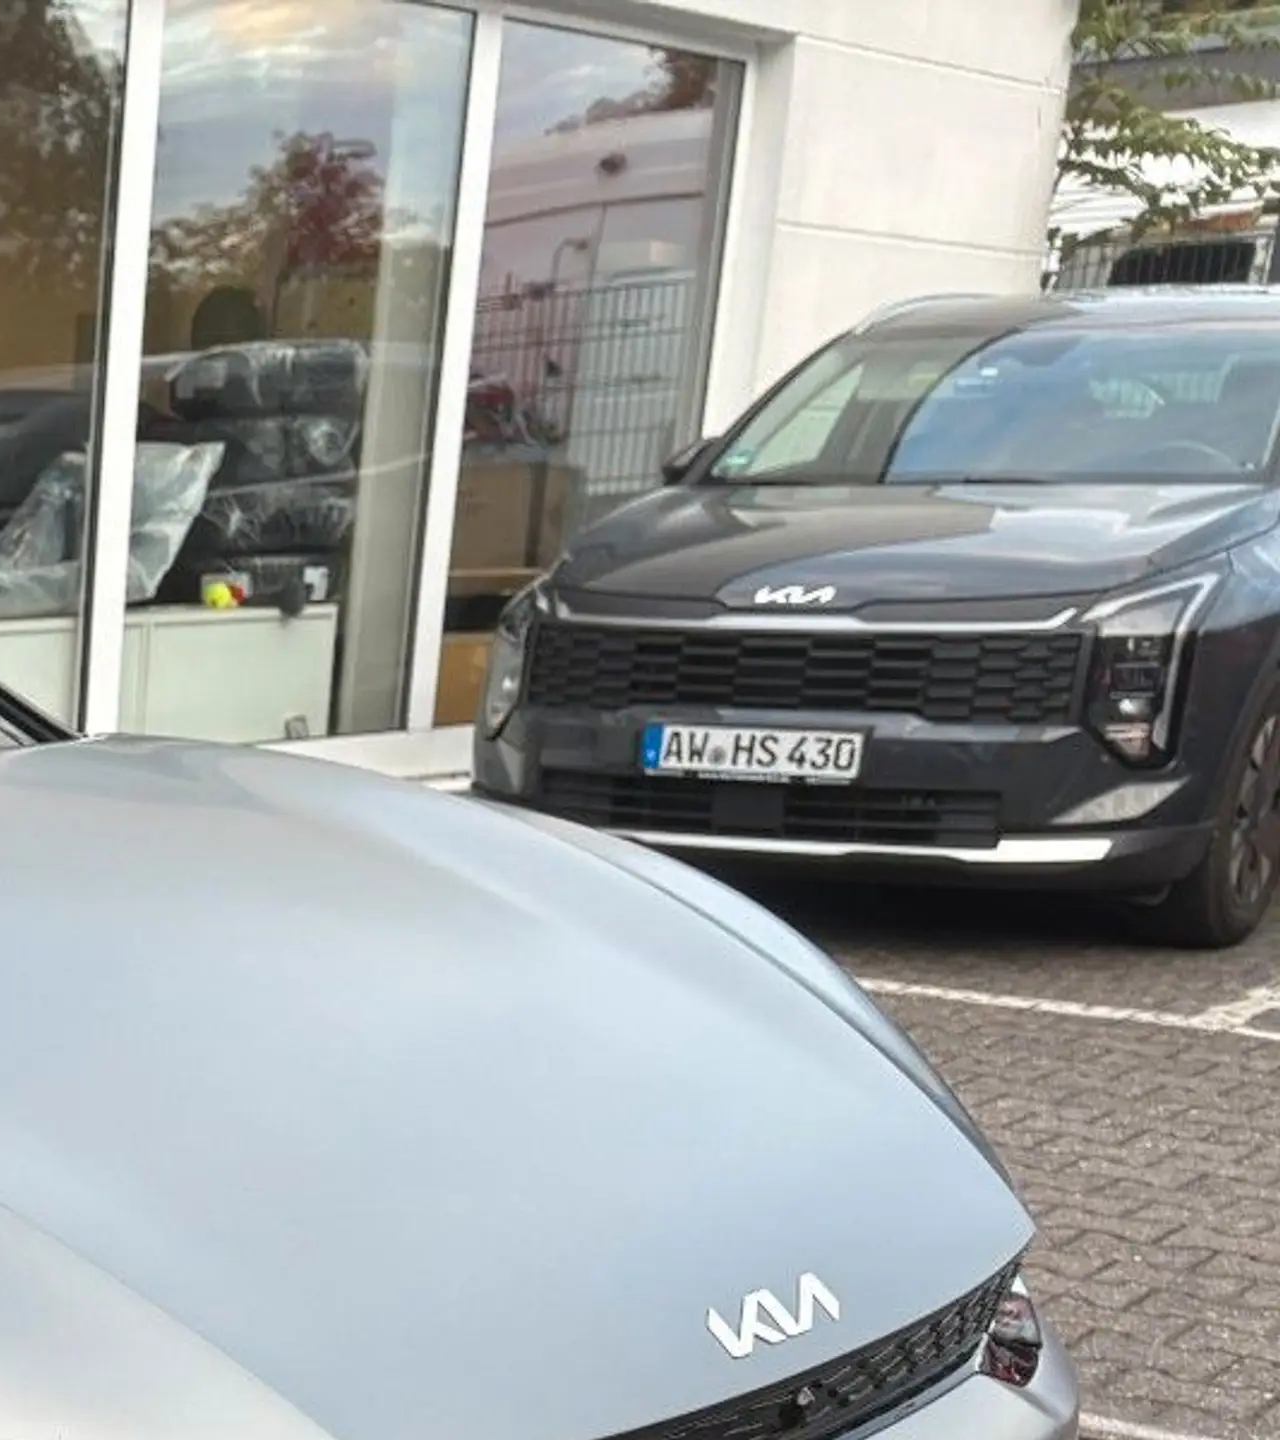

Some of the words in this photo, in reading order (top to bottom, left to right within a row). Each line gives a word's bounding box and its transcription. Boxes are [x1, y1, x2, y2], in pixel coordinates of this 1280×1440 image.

[663, 731, 709, 763] AW
[731, 733, 779, 768] HS
[787, 736, 856, 771] 430
[706, 1272, 840, 1359] KIA
